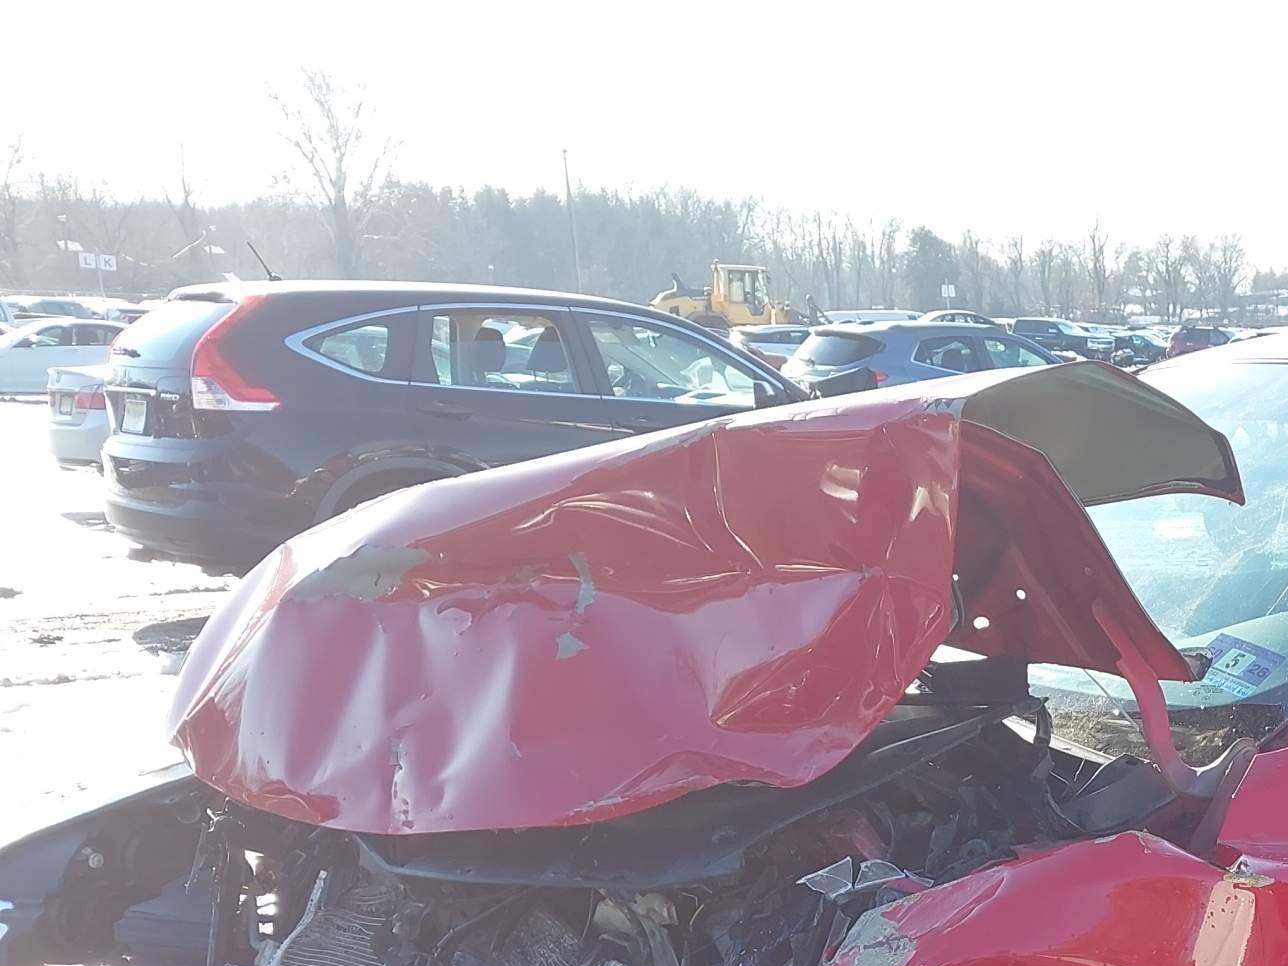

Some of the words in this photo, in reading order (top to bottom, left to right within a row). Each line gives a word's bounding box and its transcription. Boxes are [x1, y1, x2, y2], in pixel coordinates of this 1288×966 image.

[104, 257, 113, 268] K
[1225, 653, 1246, 668] 5
[1248, 664, 1270, 678] 26
